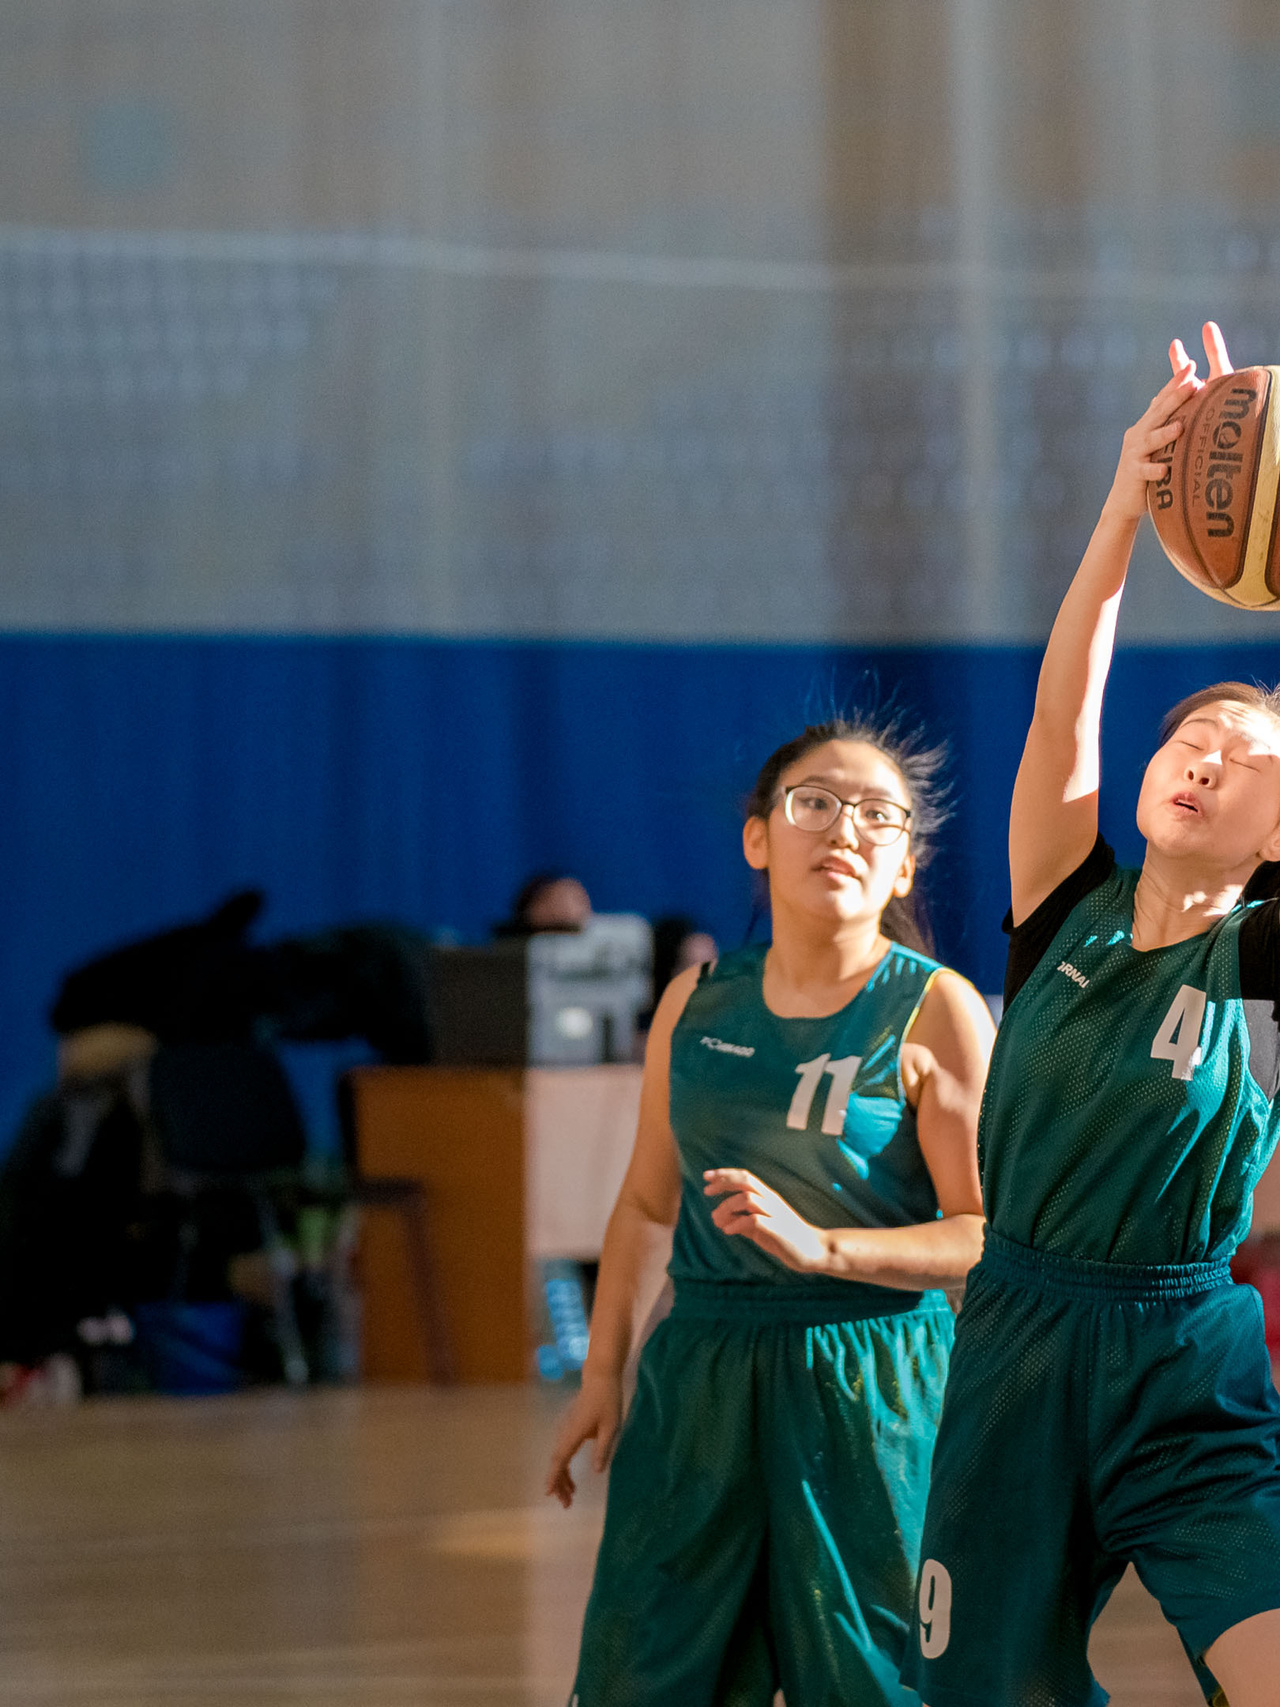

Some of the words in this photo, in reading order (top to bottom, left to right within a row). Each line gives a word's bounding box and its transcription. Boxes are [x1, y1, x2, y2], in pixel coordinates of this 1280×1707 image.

[1192, 408, 1215, 508] OFFICIAL
[1204, 388, 1257, 538] molten
[1151, 984, 1207, 1081] 4
[786, 1053, 862, 1136] 11
[919, 1559, 952, 1659] 9
